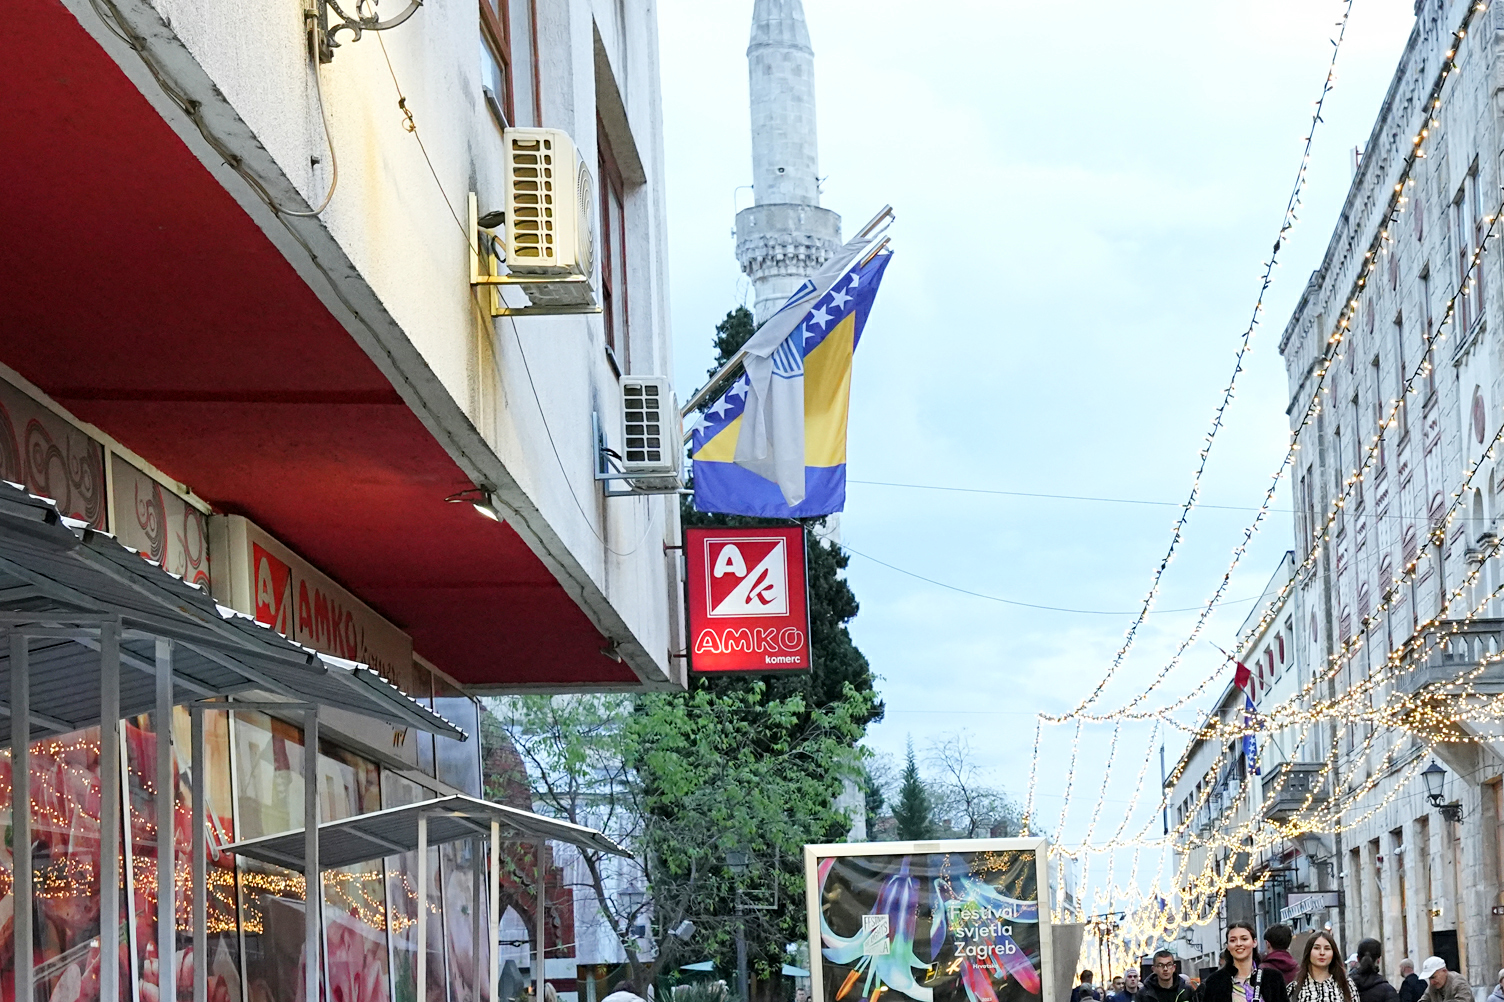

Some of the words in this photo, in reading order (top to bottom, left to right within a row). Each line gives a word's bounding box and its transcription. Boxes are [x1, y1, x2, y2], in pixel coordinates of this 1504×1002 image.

[300, 579, 357, 662] AMKO
[695, 627, 804, 653] AMKO
[765, 655, 801, 664] komerc
[950, 903, 1017, 920] Festival
[957, 922, 1013, 941] svjetla
[954, 940, 1016, 960] Zagreb
